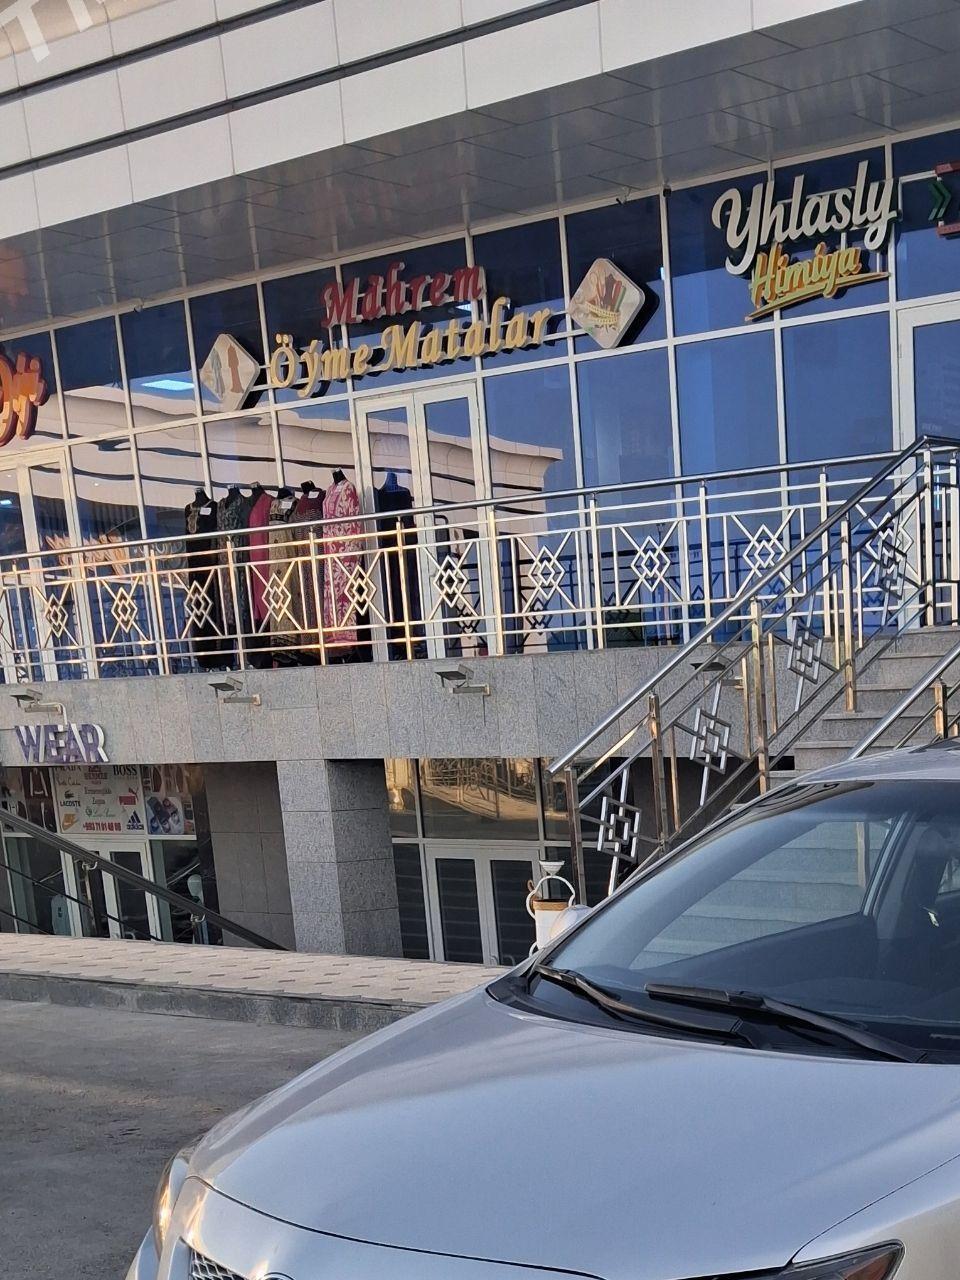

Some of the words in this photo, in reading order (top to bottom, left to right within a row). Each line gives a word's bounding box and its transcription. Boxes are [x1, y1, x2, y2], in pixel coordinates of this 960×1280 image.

[712, 160, 897, 275] Yhlasly
[270, 333, 371, 398] Öýme
[381, 297, 551, 370] Matalar
[14, 723, 109, 763] WEAR
